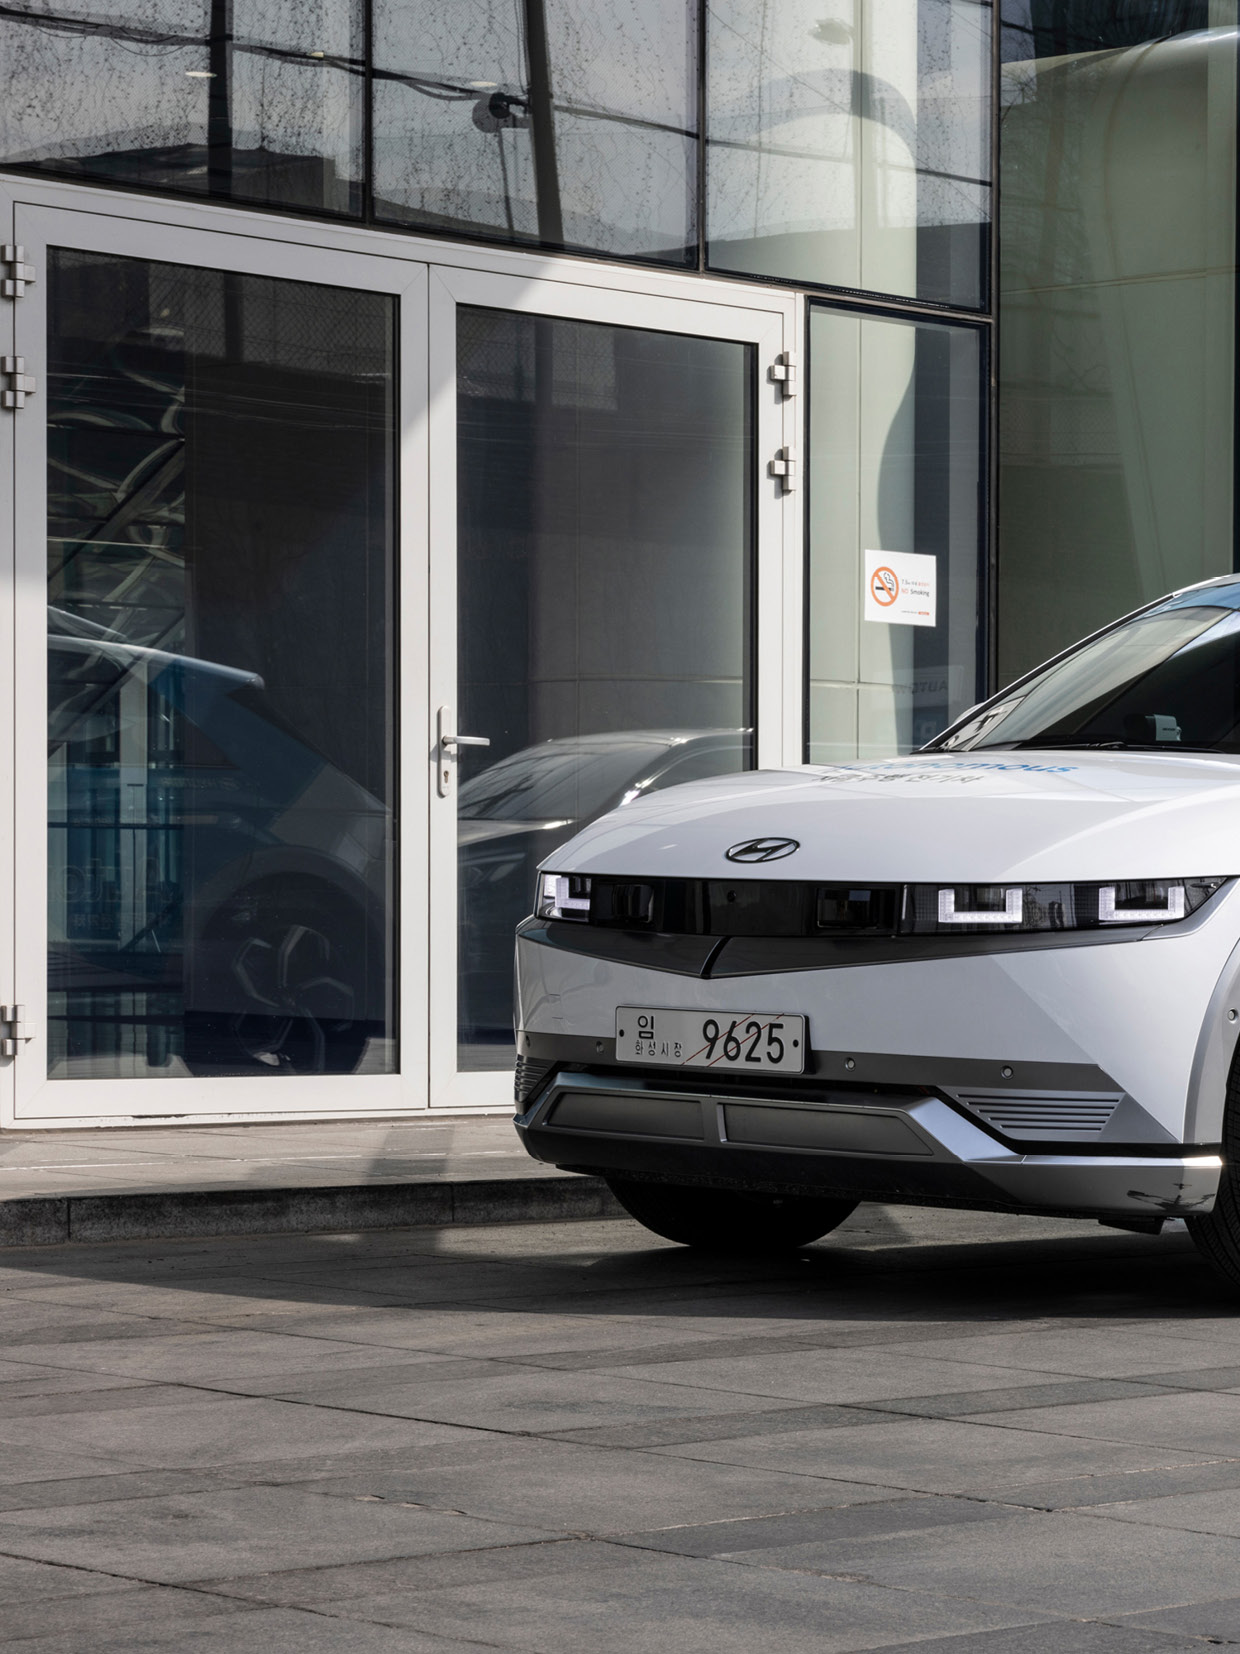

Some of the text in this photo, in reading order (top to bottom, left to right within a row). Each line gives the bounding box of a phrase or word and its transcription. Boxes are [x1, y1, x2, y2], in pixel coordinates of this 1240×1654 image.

[910, 588, 930, 598] Smoking
[637, 1015, 785, 1064] 임 9625
